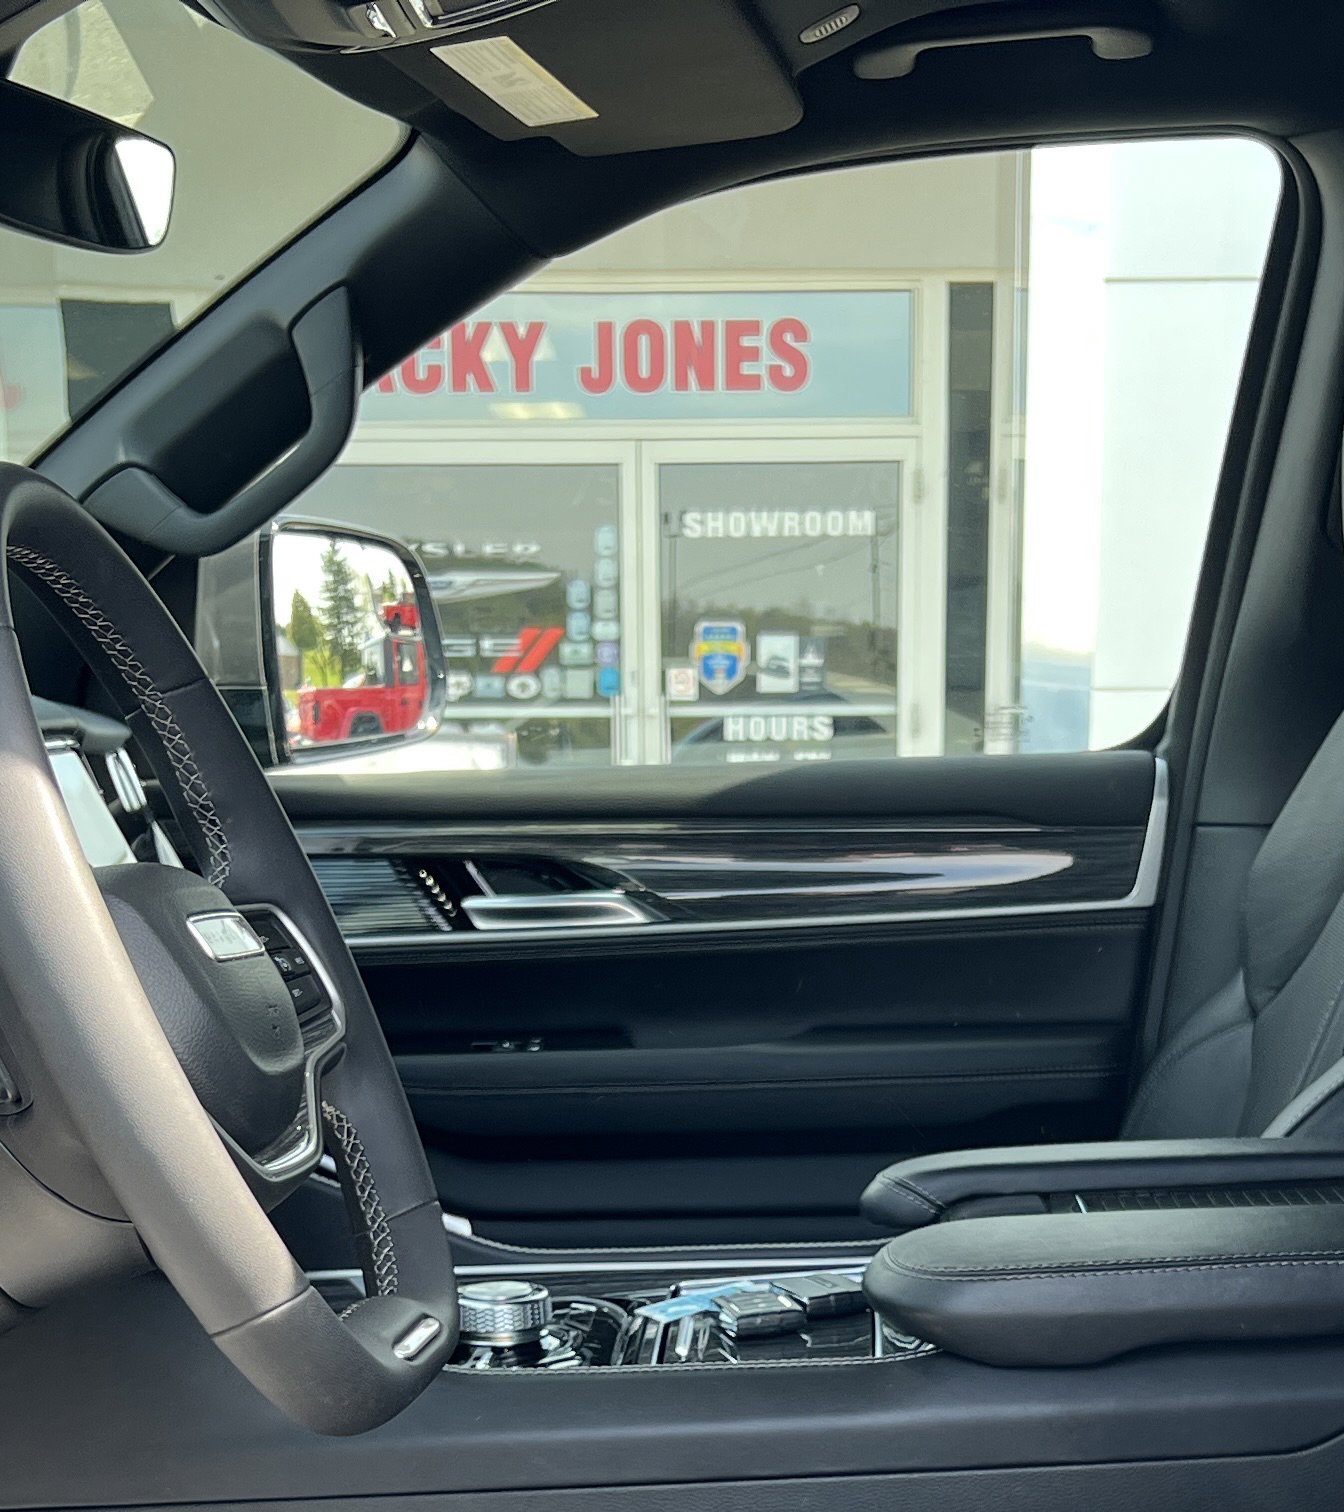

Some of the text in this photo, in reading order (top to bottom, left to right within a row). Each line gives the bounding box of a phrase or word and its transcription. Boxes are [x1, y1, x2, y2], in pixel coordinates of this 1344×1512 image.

[577, 317, 810, 395] JONES
[682, 510, 877, 538] SHOWROOM
[723, 714, 835, 742] HOURS
